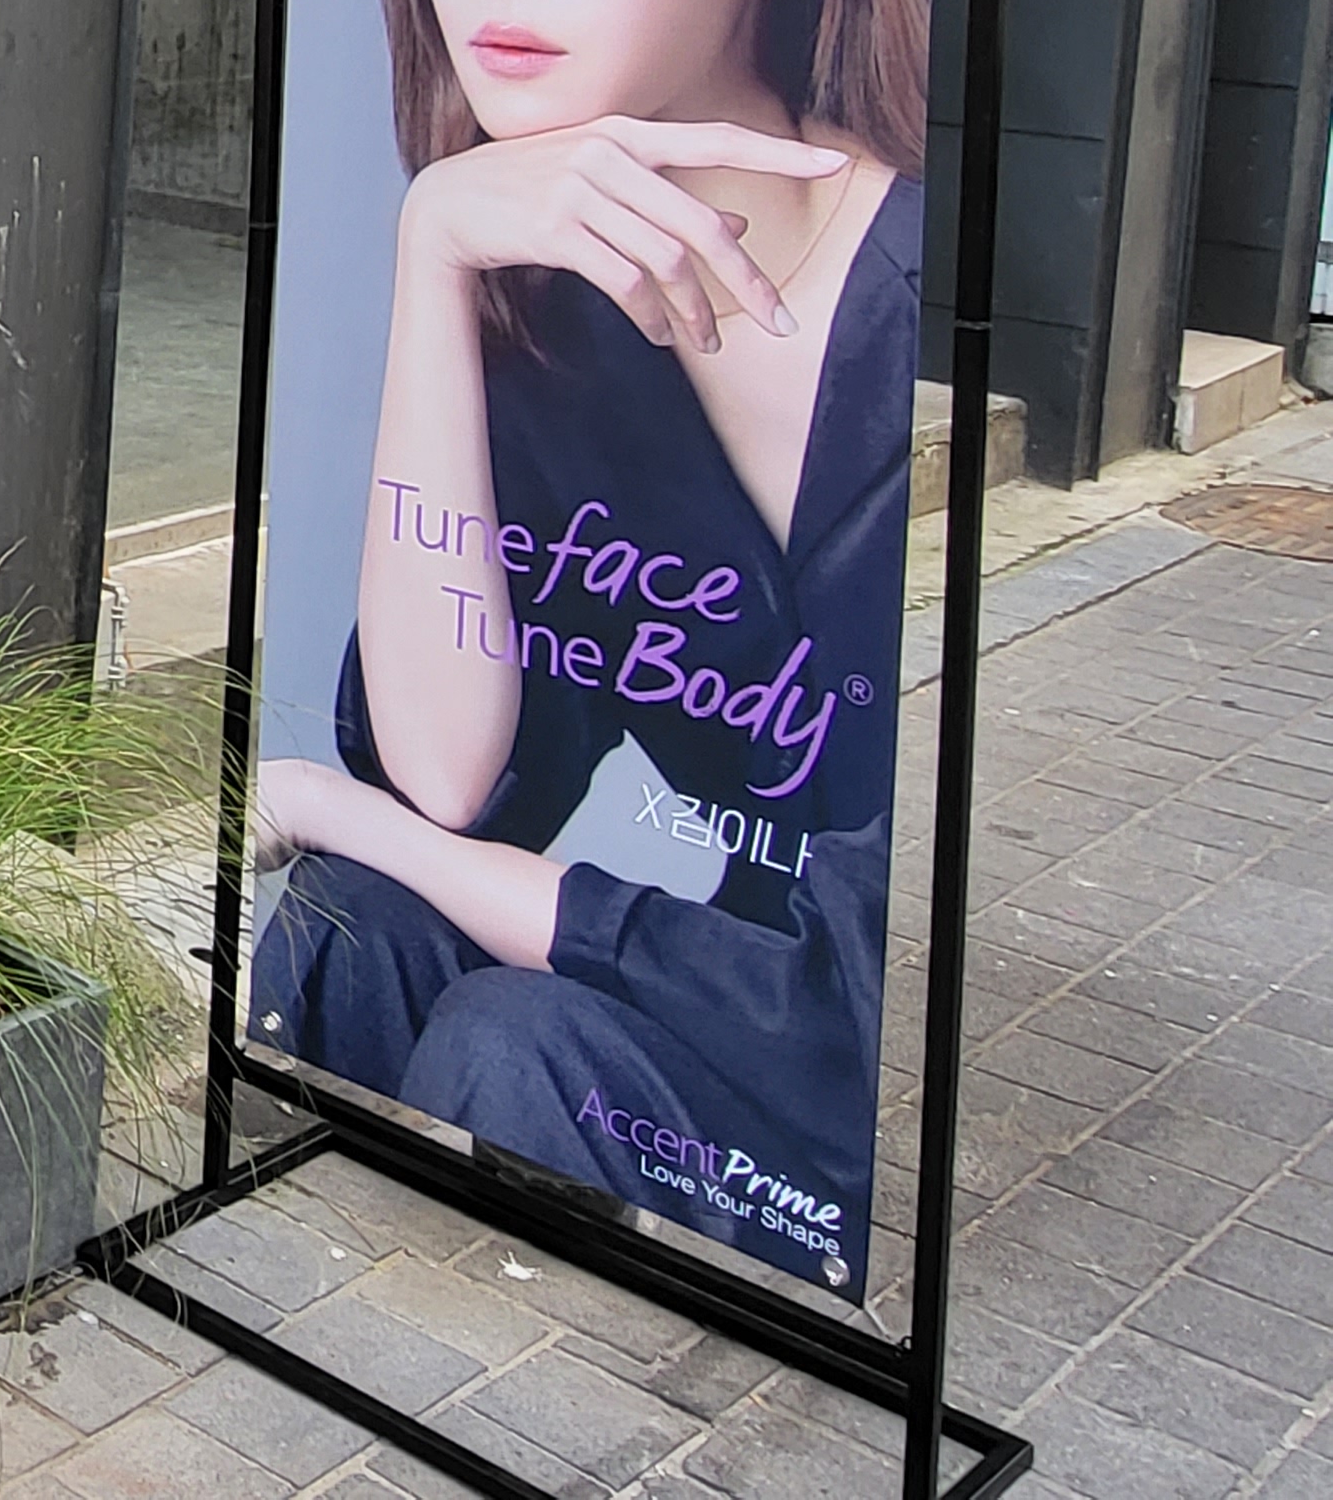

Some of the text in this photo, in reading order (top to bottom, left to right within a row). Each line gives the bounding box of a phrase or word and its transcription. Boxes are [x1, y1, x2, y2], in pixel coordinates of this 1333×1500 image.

[640, 1154, 840, 1256] Love Your Shape
